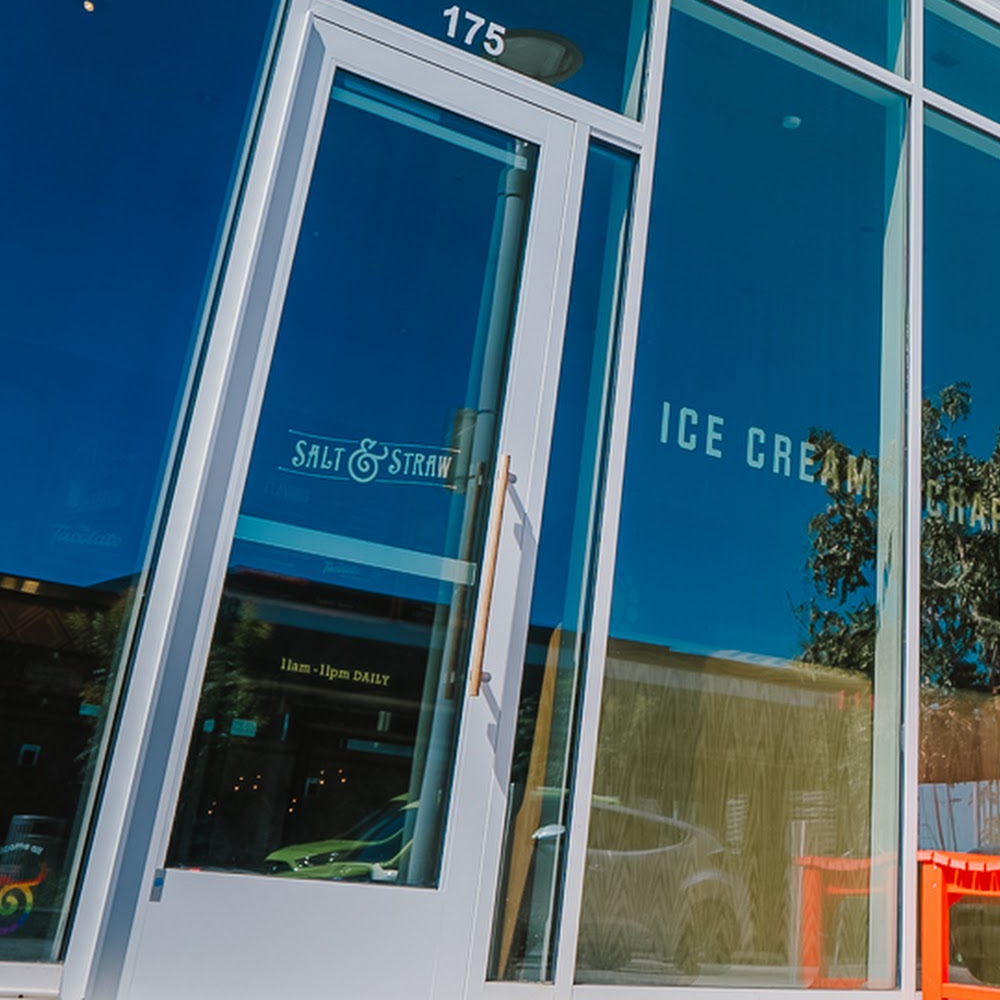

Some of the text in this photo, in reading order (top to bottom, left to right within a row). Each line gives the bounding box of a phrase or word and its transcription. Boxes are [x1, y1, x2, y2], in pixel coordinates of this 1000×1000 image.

[443, 5, 506, 56] 175
[291, 438, 452, 483] SALT & STRAW
[660, 401, 872, 498] ICE CREAM
[353, 669, 390, 686] DAILY
